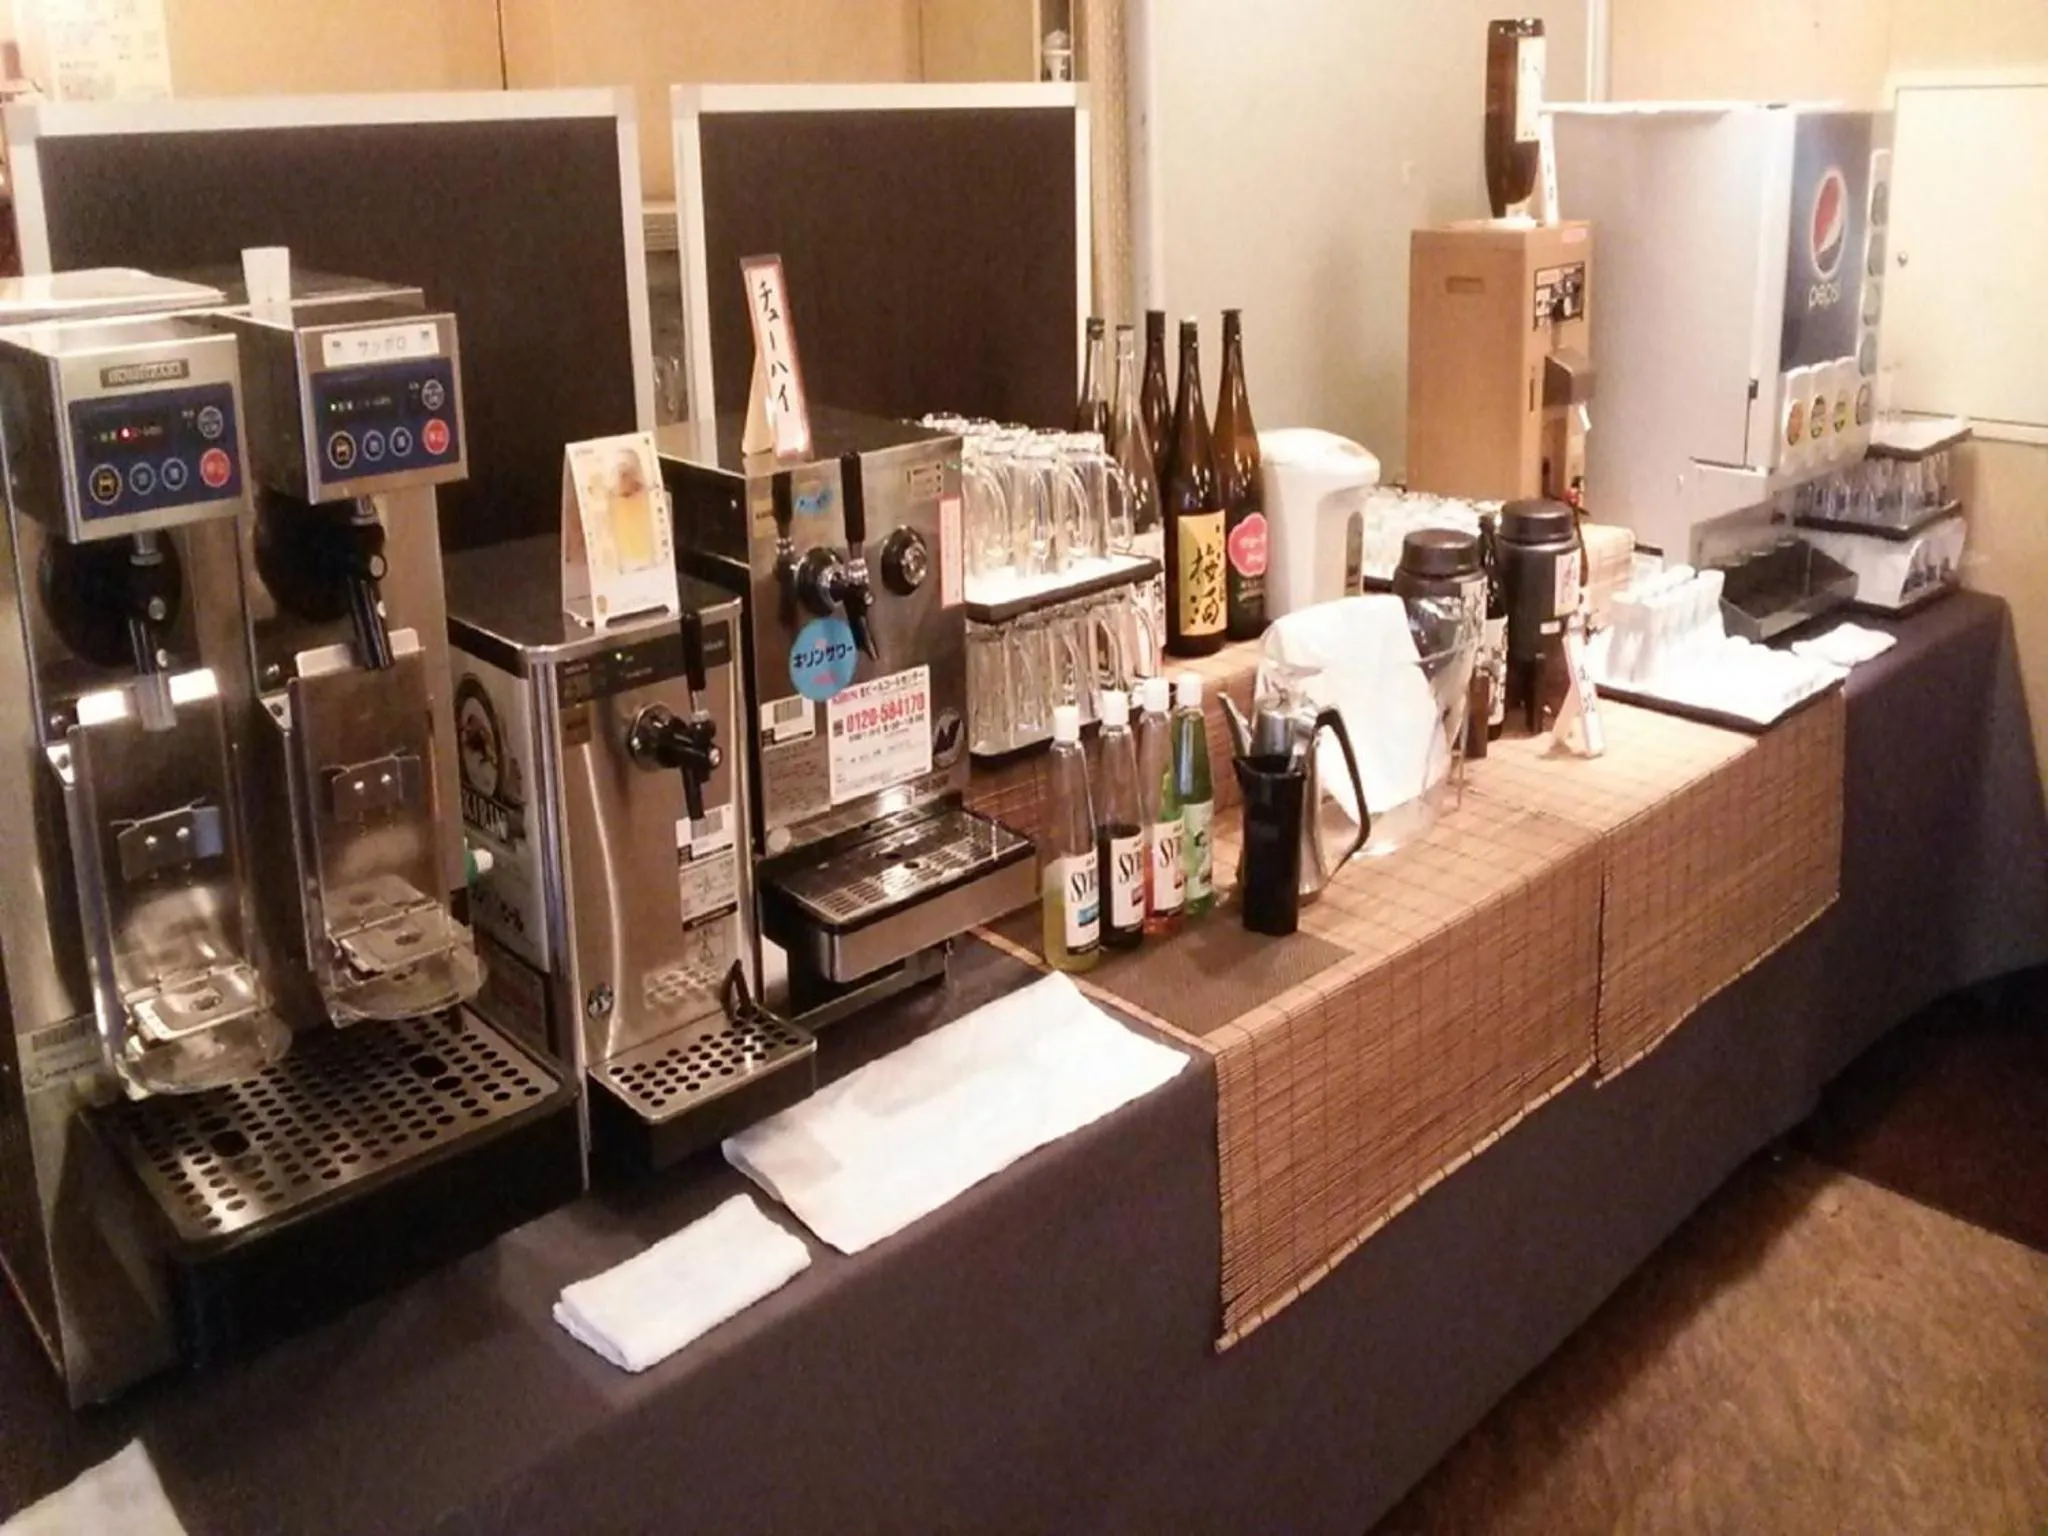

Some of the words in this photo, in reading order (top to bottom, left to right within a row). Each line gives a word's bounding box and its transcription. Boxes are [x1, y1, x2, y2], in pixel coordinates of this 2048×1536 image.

[758, 281, 790, 413] チューハイ
[1189, 543, 1220, 626] 梅酒
[793, 642, 853, 669] キリンサワー
